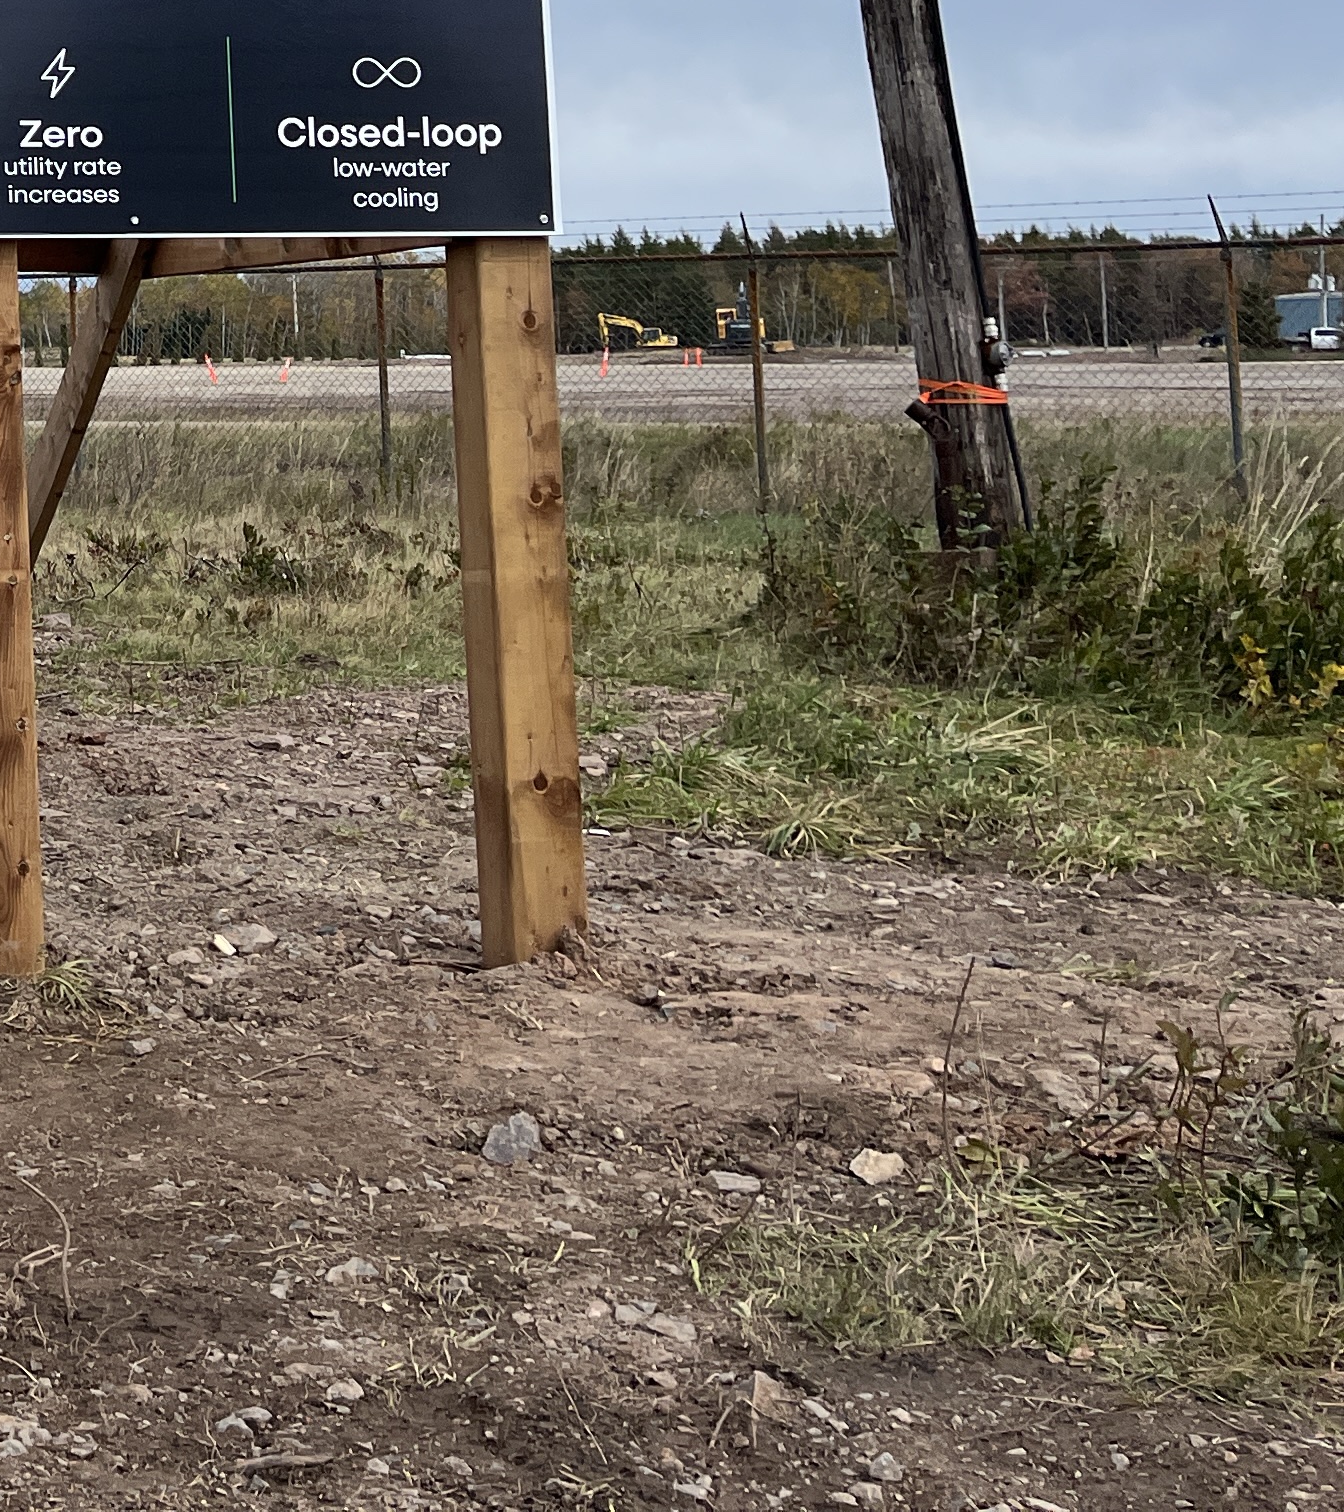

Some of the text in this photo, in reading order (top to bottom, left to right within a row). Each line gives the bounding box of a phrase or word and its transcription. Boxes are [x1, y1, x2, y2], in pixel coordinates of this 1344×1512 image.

[19, 119, 103, 148] Zero
[277, 115, 502, 155] Closed-loop
[4, 156, 122, 180] utility rate
[333, 157, 451, 178] low-water
[7, 184, 120, 204] increases
[353, 187, 439, 212] cooling
